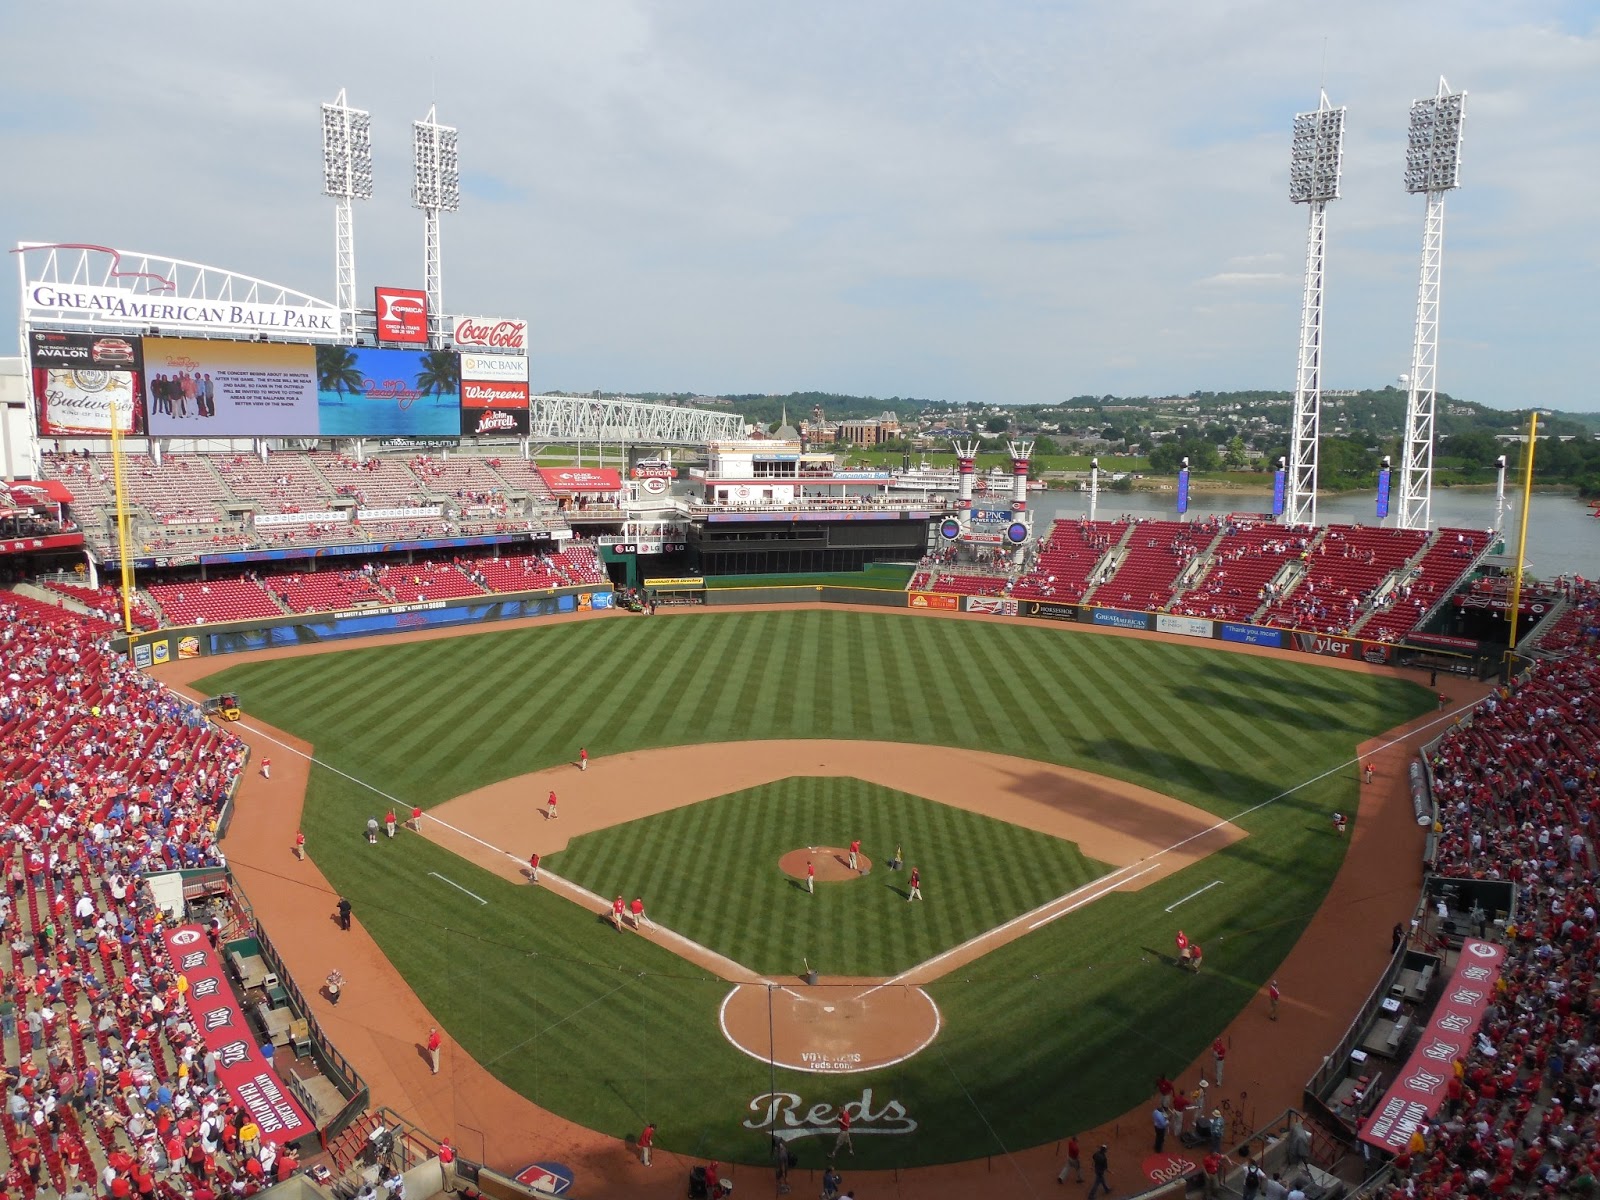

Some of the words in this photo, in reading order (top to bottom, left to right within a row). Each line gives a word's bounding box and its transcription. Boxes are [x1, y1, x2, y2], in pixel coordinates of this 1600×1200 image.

[34, 286, 116, 310] GREAT
[110, 298, 225, 322] AMERICAN
[455, 319, 526, 348] Coca-Cola
[37, 349, 88, 357] AVALON
[477, 360, 497, 370] PNC
[498, 361, 523, 370] BANK
[465, 386, 526, 402] Walgreens
[475, 415, 518, 433] Morrell
[1114, 617, 1145, 626] AMERICAN
[1226, 625, 1247, 633] "Thank
[1292, 632, 1350, 654] Wyler
[196, 979, 217, 995] 1961
[208, 1008, 230, 1028] 1970
[1441, 1015, 1469, 1032] 1975
[223, 1041, 246, 1064] 1972
[1426, 1043, 1455, 1061] 1940
[1409, 1073, 1440, 1092] 1919
[237, 1082, 283, 1133] CHAMPIONS
[254, 1073, 284, 1104] NATIONAL
[274, 1102, 302, 1130] LEAGUE
[743, 1088, 918, 1142] Reds
[1370, 1115, 1394, 1138] WORLD
[1383, 1097, 1406, 1119] SERIES
[1386, 1101, 1428, 1146] CHAMPIONS
[1150, 1158, 1197, 1184] Reds
